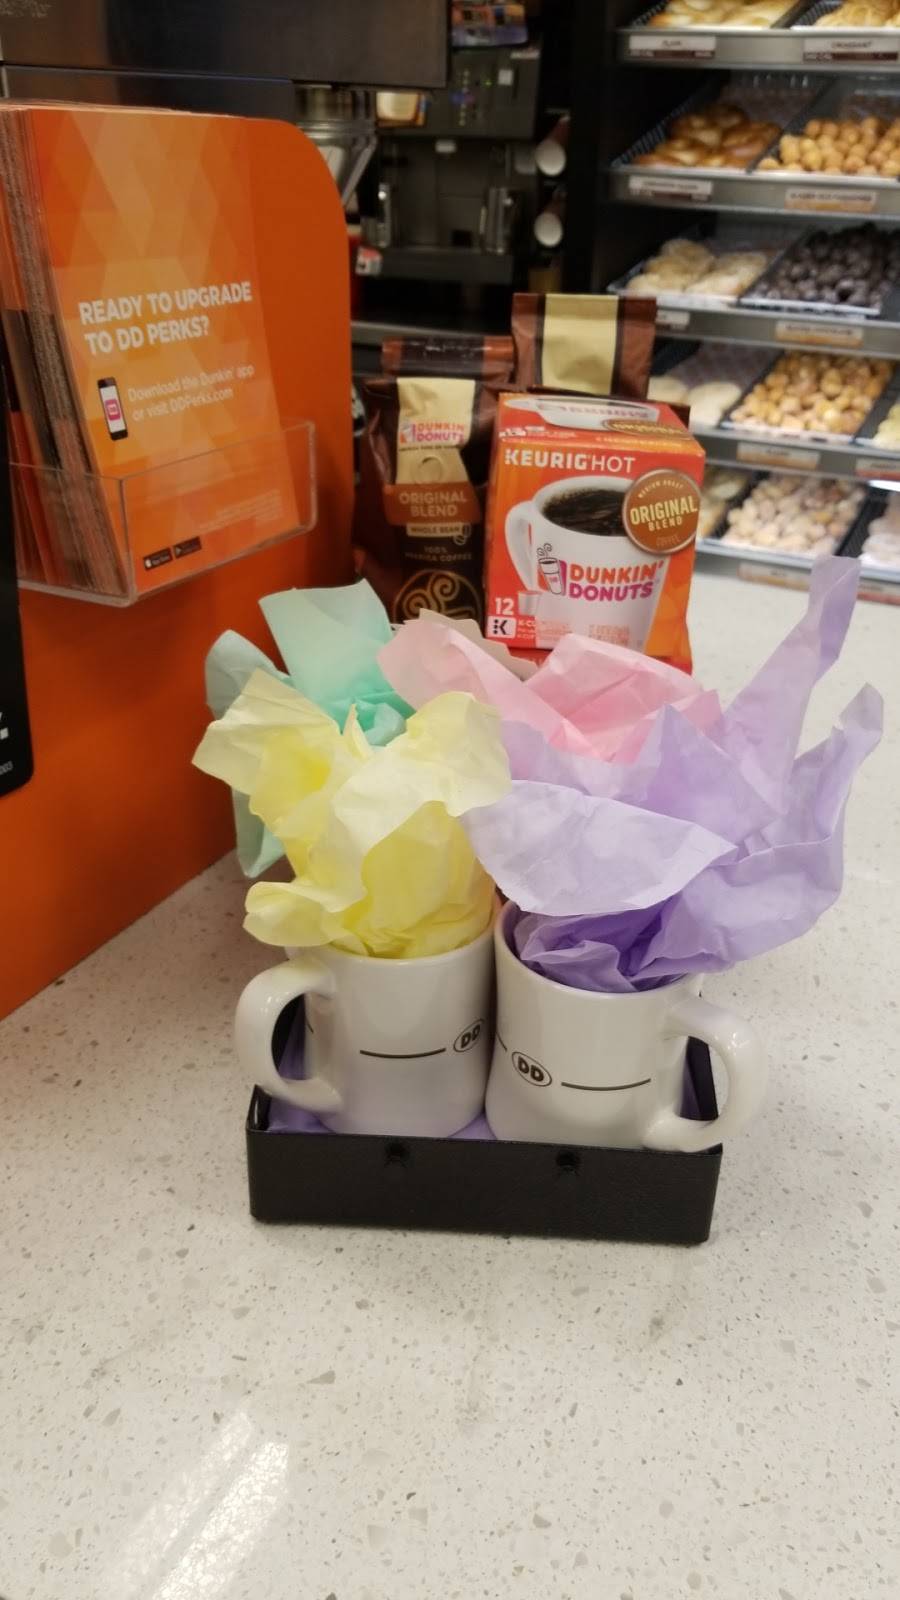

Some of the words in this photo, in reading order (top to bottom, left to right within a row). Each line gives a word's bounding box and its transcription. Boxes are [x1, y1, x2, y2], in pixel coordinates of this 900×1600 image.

[78, 295, 142, 325] READY
[147, 292, 173, 315] TO
[174, 281, 252, 310] UPGRADE
[84, 331, 113, 356] TO
[115, 326, 144, 351] DD
[146, 315, 210, 345] PERKS?
[127, 378, 181, 402] Download
[181, 376, 198, 391] the
[236, 365, 255, 380] app
[132, 410, 144, 422] or
[148, 401, 170, 418] visit
[170, 388, 234, 412] DDPerks.com
[504, 448, 588, 471] KEURIG
[591, 455, 636, 473] HOT
[400, 491, 468, 505] ORIGINAL
[410, 504, 458, 517] BLEND
[630, 495, 698, 526] ORIGINAL
[648, 515, 683, 532] BLEND
[568, 559, 664, 585] DUNKIN'
[568, 581, 654, 602] DONUTS
[494, 597, 515, 616] 12
[461, 1023, 480, 1049] DD
[518, 1055, 545, 1082] DD
